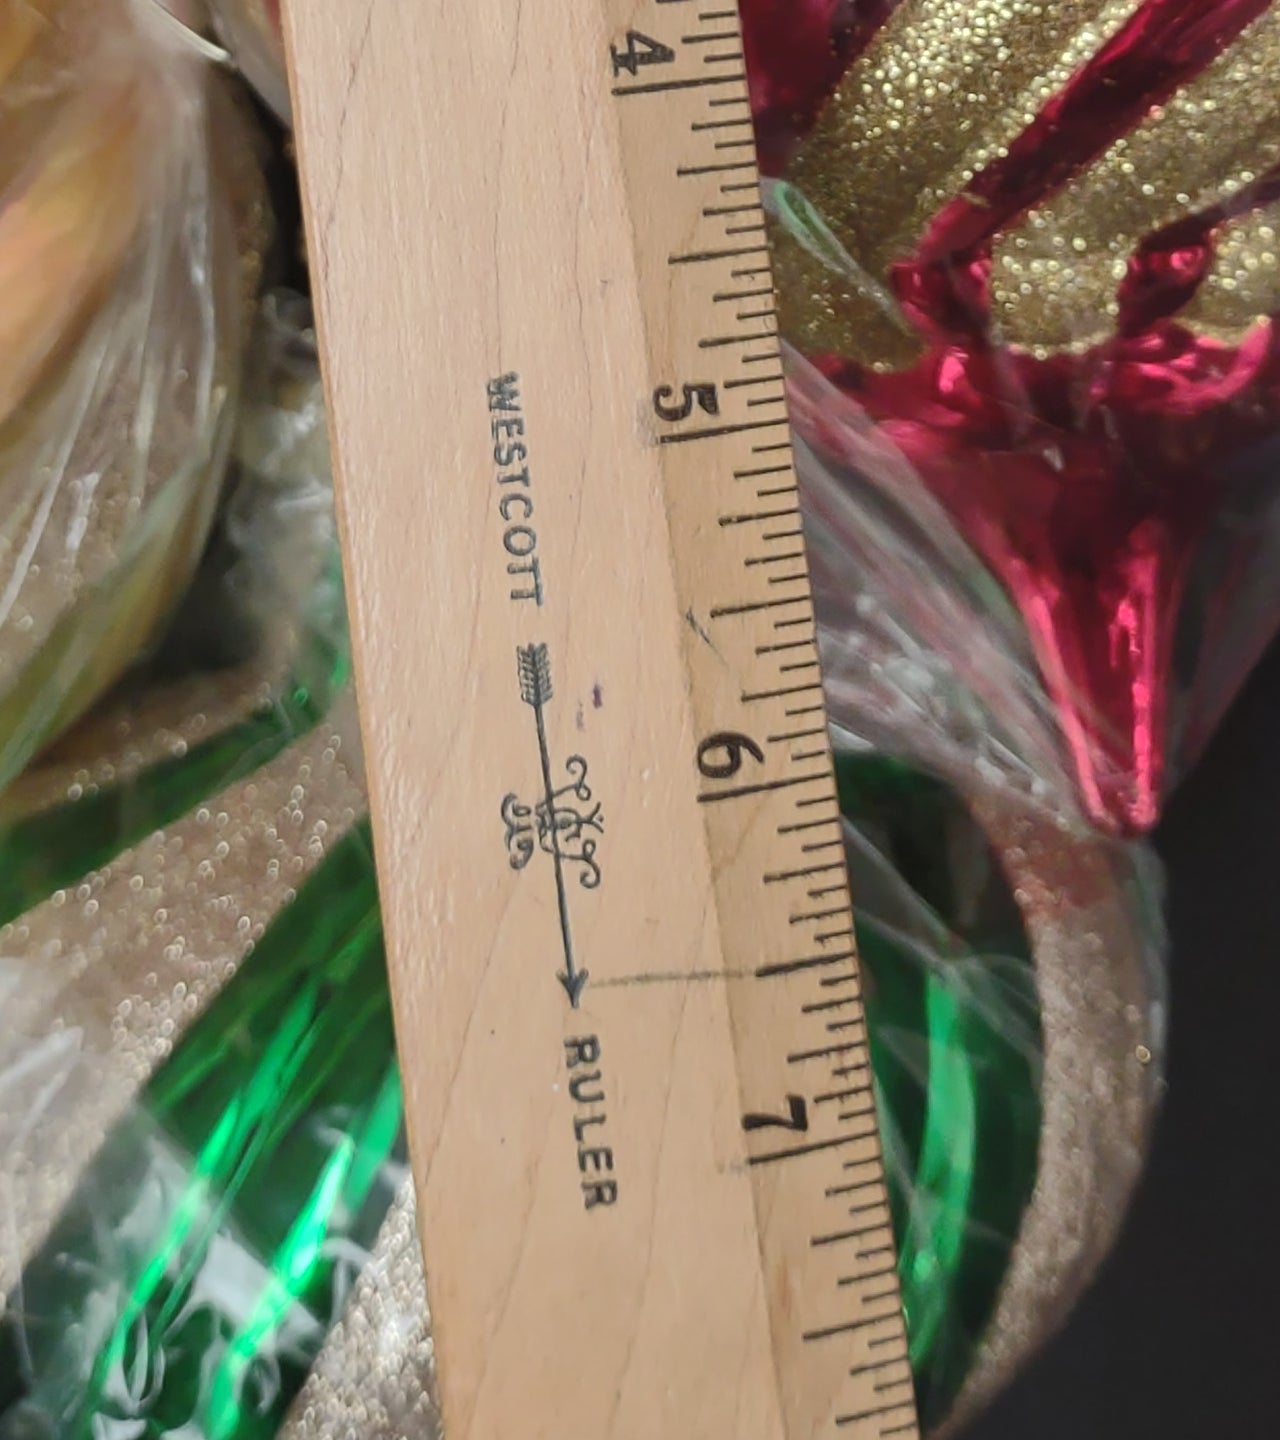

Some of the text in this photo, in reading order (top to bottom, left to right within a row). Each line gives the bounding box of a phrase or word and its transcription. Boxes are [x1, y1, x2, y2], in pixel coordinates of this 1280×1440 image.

[610, 29, 676, 77] 4
[652, 382, 720, 422] 5
[487, 371, 544, 607] WESTCOTT
[696, 731, 765, 779] 6
[563, 1033, 618, 1211] RULER
[741, 1094, 809, 1133] 7
